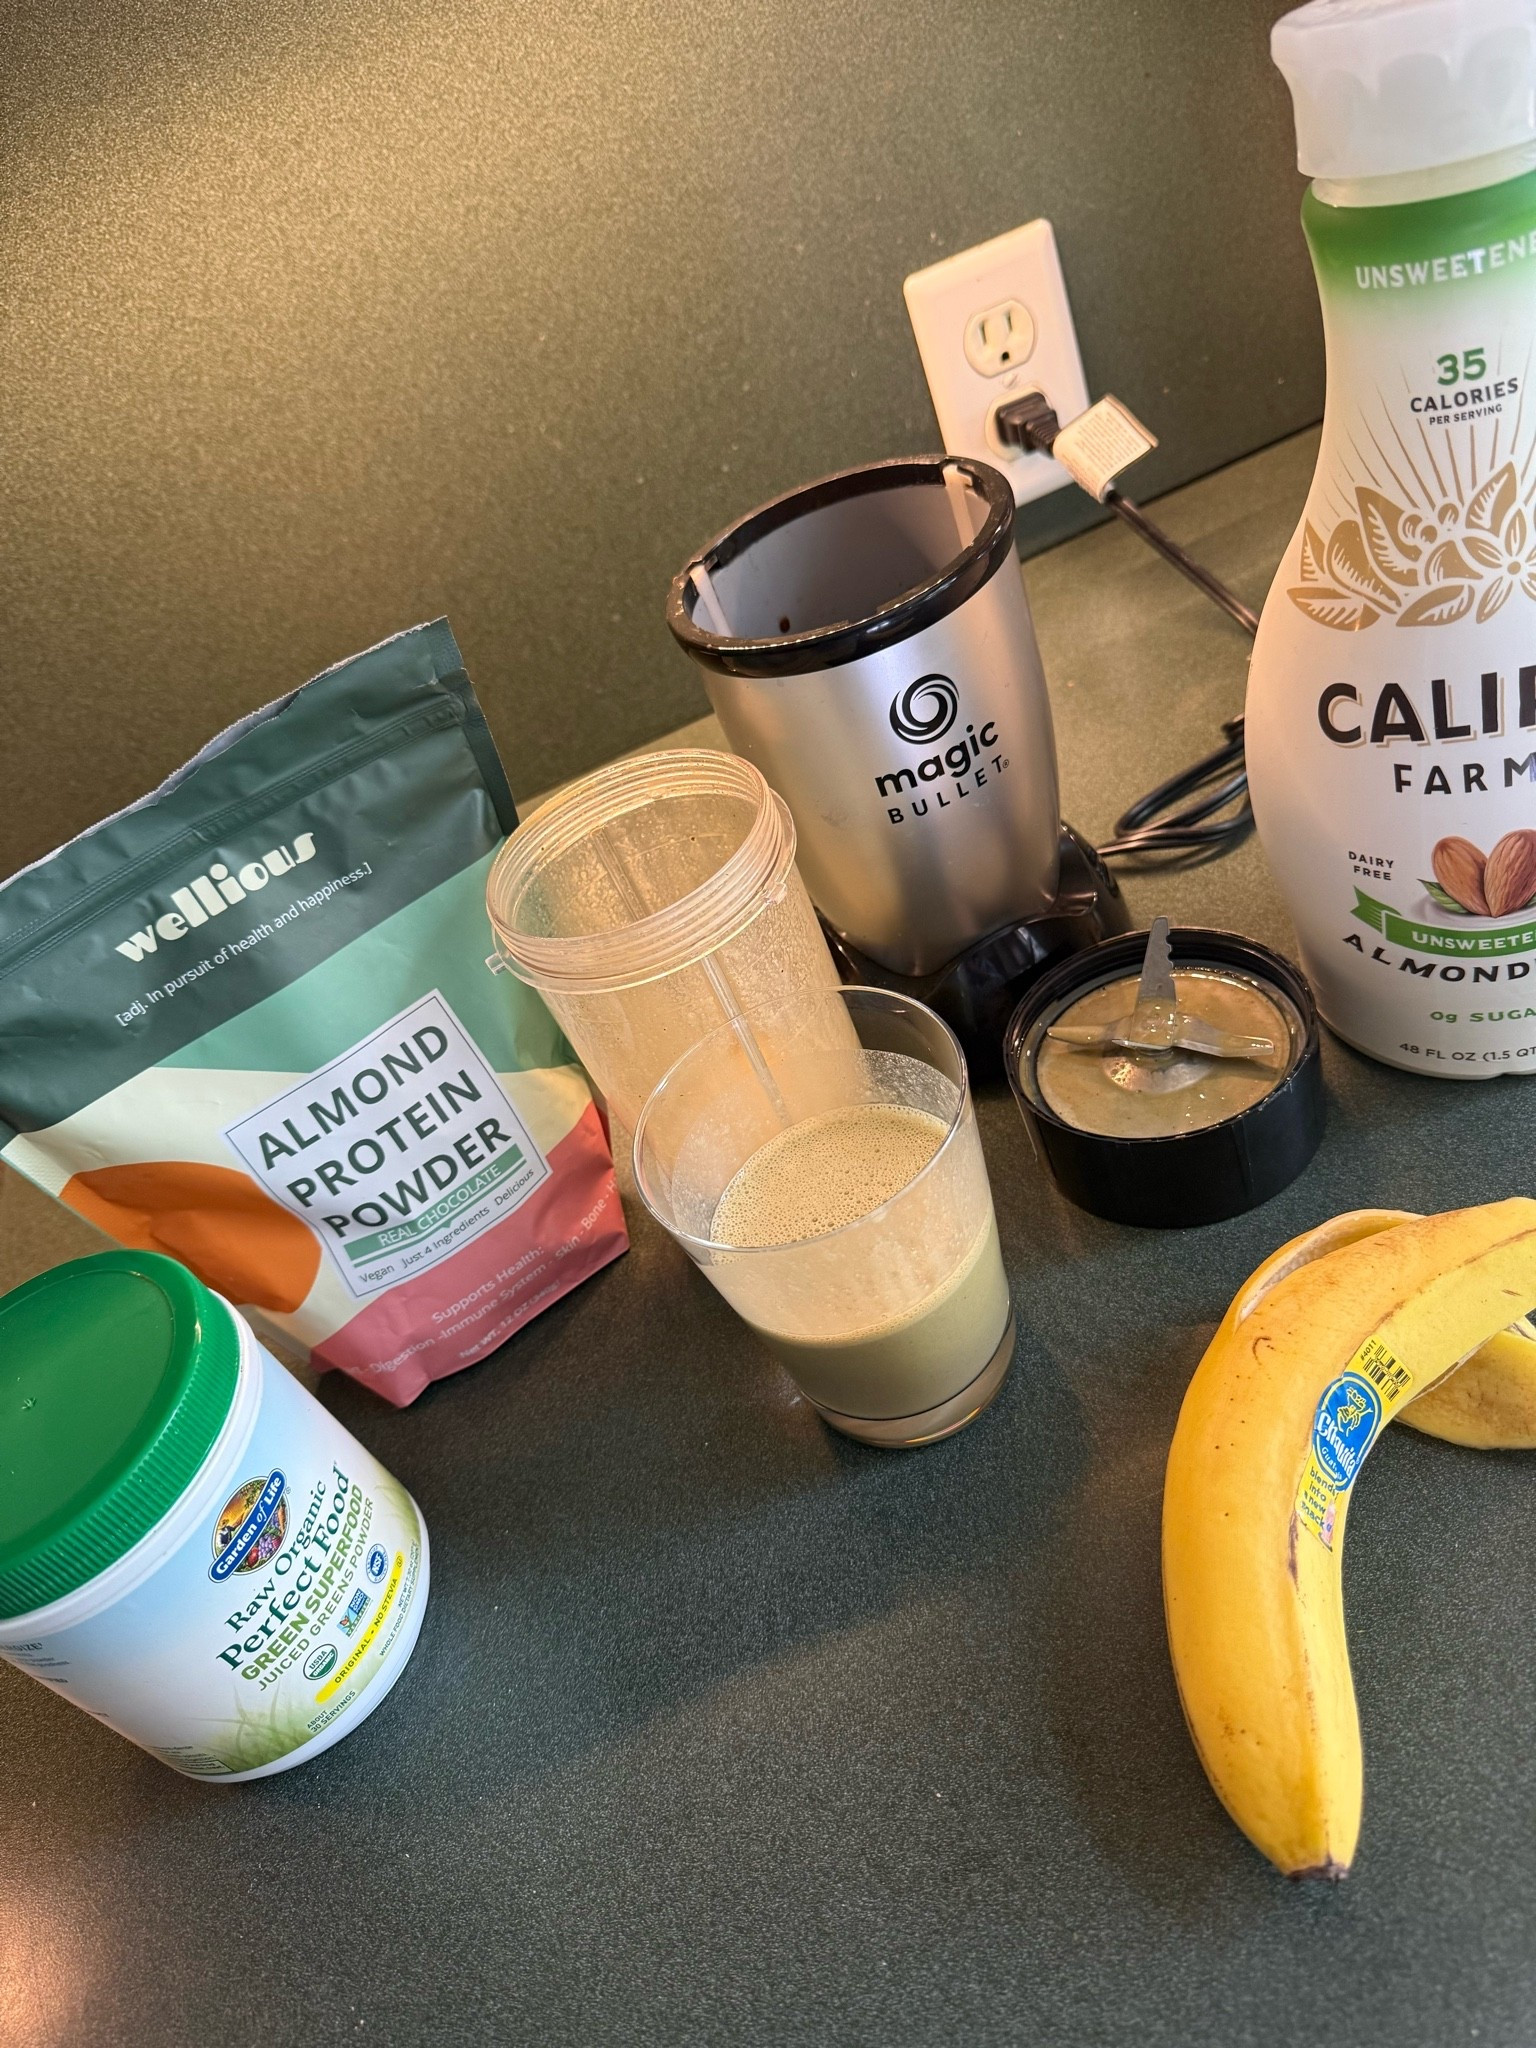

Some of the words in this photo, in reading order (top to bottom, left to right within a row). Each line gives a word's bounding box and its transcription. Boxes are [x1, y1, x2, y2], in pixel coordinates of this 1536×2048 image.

[1410, 377, 1518, 413] CALORIES
[1437, 347, 1487, 386] 35
[1429, 415, 1450, 425] PER
[1454, 403, 1502, 422] SERVING
[875, 721, 999, 798] magic
[887, 754, 1003, 825] BULLET
[115, 832, 317, 963] wellious
[1348, 850, 1395, 869] DAIRY
[1353, 865, 1392, 881] FREE
[145, 988, 165, 1004] In
[163, 959, 215, 997] pursuit
[214, 946, 230, 965] of
[228, 923, 275, 956] health
[274, 904, 300, 929] and
[1342, 933, 1536, 984] ALMOND
[1399, 1043, 1420, 1054] 48
[1425, 1048, 1447, 1060] FL
[1451, 1051, 1477, 1061] OZ
[1482, 1050, 1511, 1062] (1.5
[256, 1024, 449, 1171] ALMOND
[286, 1068, 484, 1208] PROTEIN
[321, 1116, 513, 1239] POWDER
[377, 1224, 418, 1247] REAL
[416, 1163, 502, 1231] CHOCOLATE
[359, 1264, 395, 1283] Vegan
[401, 1251, 425, 1269] Just
[425, 1245, 433, 1255] 4
[432, 1205, 491, 1250] Ingredients
[493, 1168, 535, 1206] Delicious
[368, 1337, 436, 1374] Digestion
[499, 1263, 547, 1301] System
[554, 1234, 581, 1260] Skin
[580, 1197, 607, 1231] Bone
[431, 1279, 497, 1324] Supports
[495, 1245, 545, 1283] Health:
[216, 1523, 258, 1574] Garden
[256, 1499, 268, 1523] of
[263, 1477, 283, 1506] Life
[1308, 1495, 1326, 1515] new
[1309, 1480, 1327, 1502] into
[215, 1554, 323, 1671] Perfect
[310, 1464, 350, 1555] Food
[224, 1577, 277, 1633] Raw
[274, 1479, 327, 1576] Organic
[240, 1611, 311, 1682] GREEN
[304, 1483, 364, 1615] SUPERFOOD
[371, 1551, 382, 1575] NSF
[258, 1637, 311, 1692] JUICED
[309, 1569, 354, 1637] GREENS
[349, 1498, 374, 1569] POWDER
[333, 1637, 372, 1684] ORIGINAL
[373, 1611, 385, 1628] NO
[381, 1577, 398, 1612] STEVIA
[308, 1649, 328, 1670] USDA
[379, 1632, 395, 1656] WHOLE
[393, 1613, 404, 1631] FOOD
[306, 1709, 328, 1730] ABOUT
[310, 1723, 322, 1733] 30
[320, 1689, 356, 1725] SERVINGS
